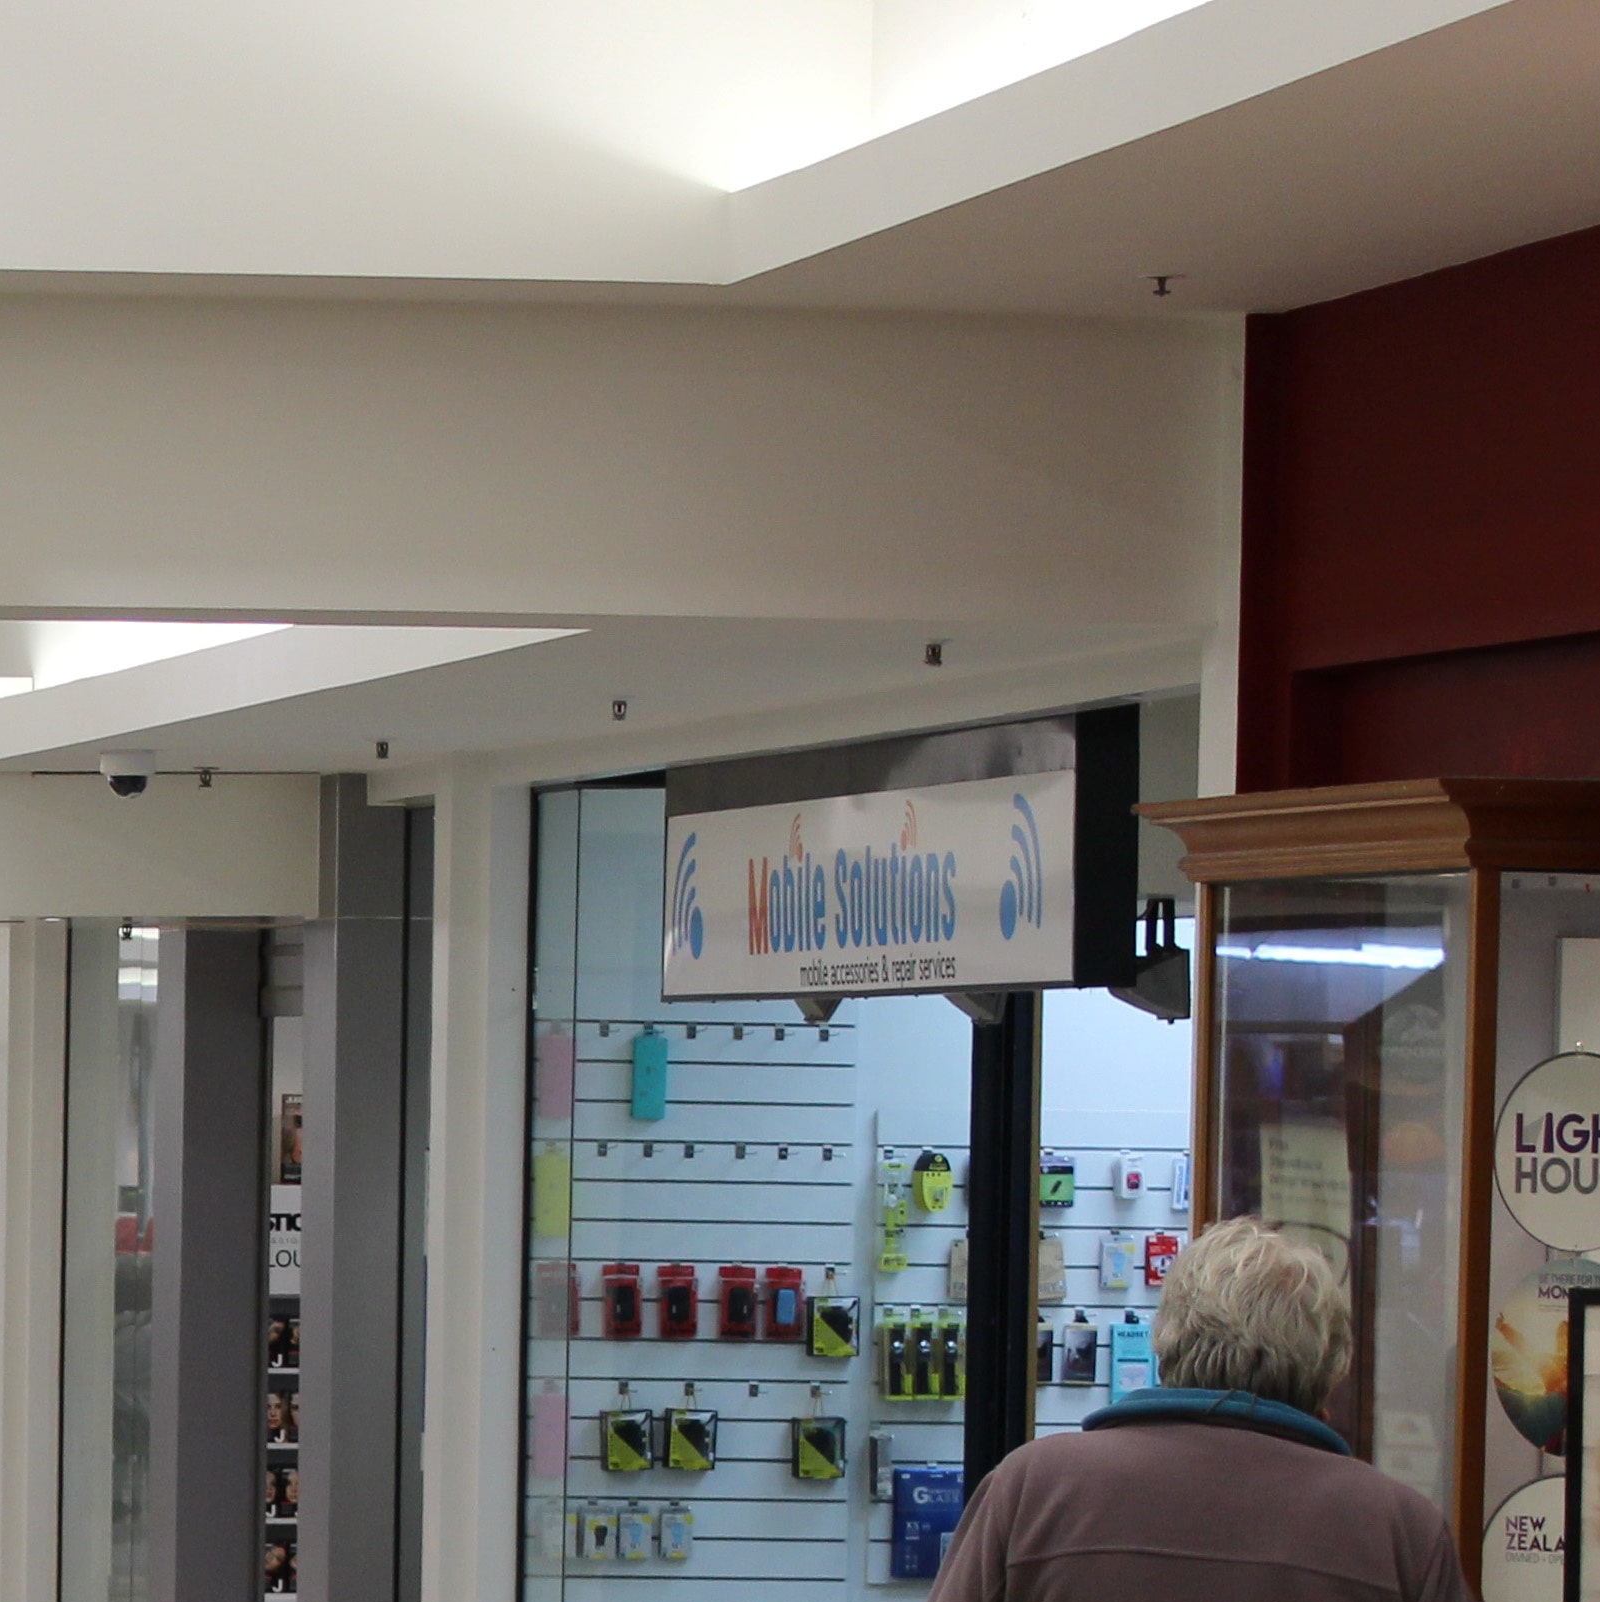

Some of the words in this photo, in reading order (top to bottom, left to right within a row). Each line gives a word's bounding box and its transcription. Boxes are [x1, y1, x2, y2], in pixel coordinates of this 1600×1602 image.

[748, 848, 826, 956] Mobile
[834, 842, 957, 949] Solutions
[800, 957, 828, 987] mobile
[831, 955, 879, 985] accessories
[882, 954, 889, 983] &
[892, 953, 916, 988] repair
[919, 951, 956, 980] services
[1505, 1515, 1546, 1531] NEW
